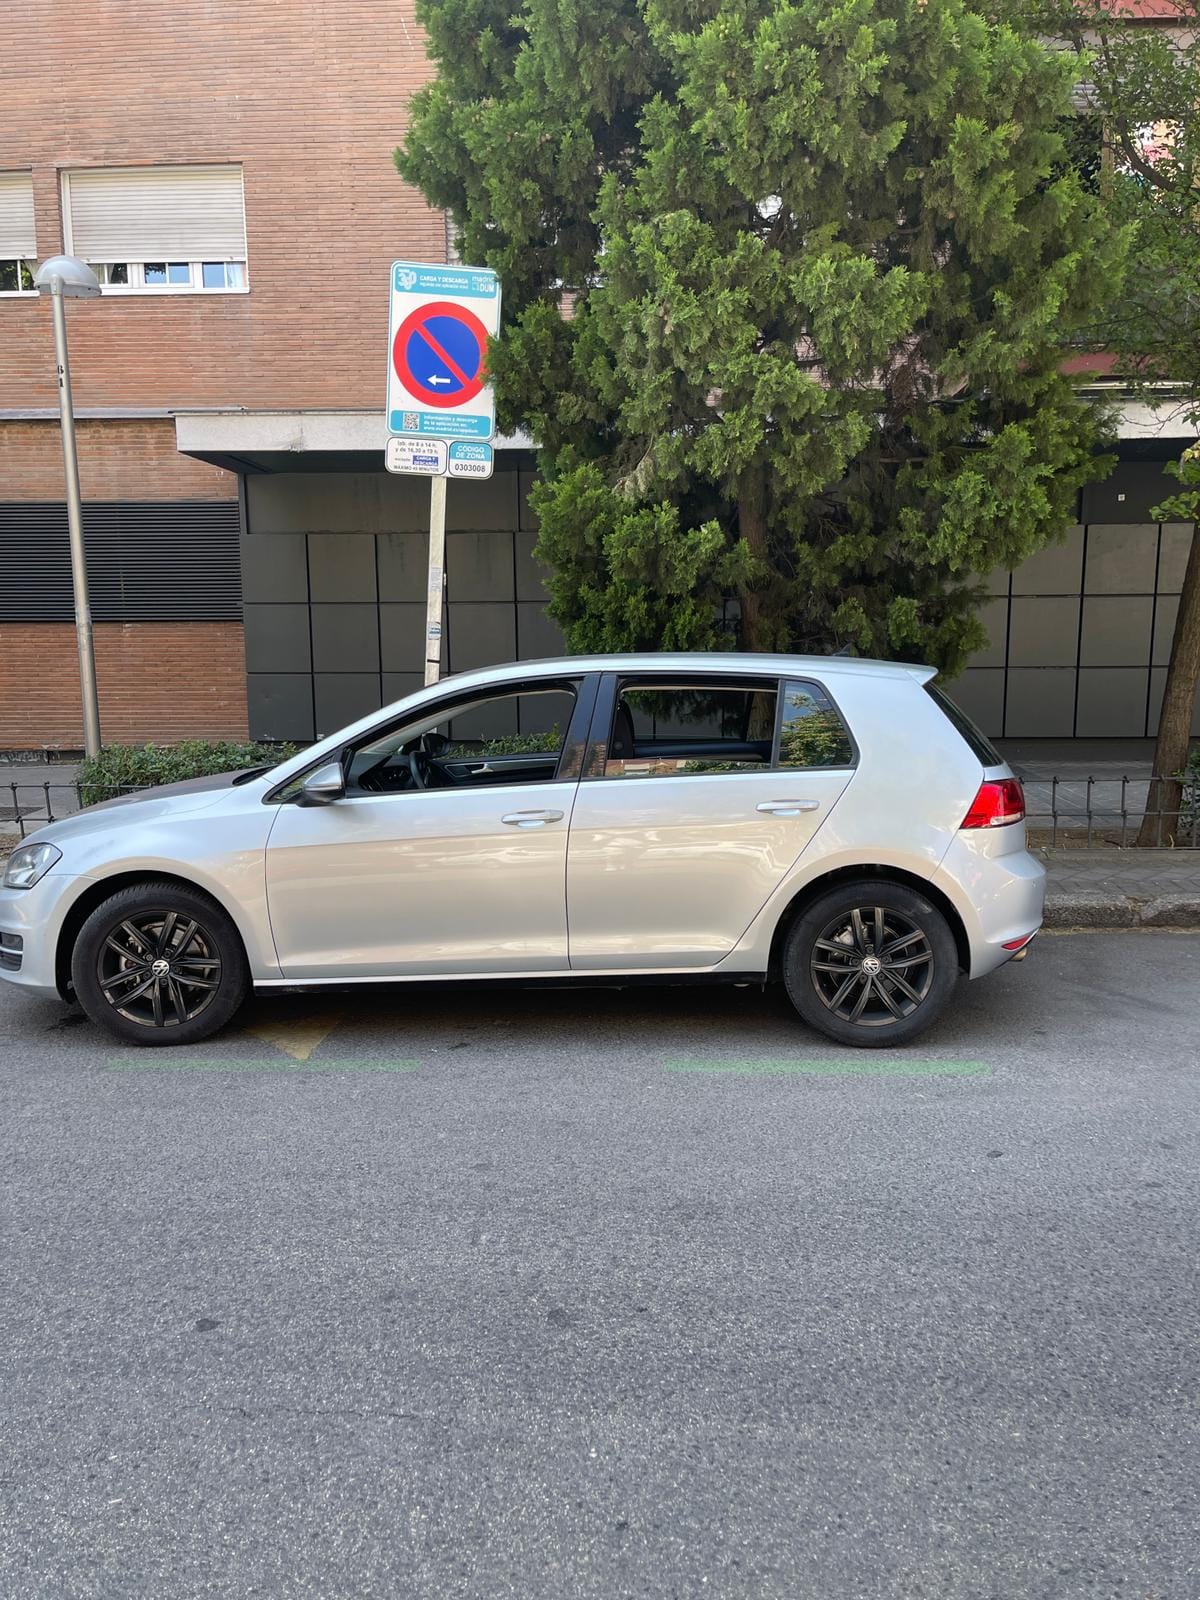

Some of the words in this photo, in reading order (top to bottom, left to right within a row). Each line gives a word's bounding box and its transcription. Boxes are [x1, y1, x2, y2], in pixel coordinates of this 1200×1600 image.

[442, 276, 469, 284] DESCARGA
[479, 283, 495, 293] DUM
[457, 445, 485, 453] CÓDIGO
[454, 463, 486, 472] 0303008
